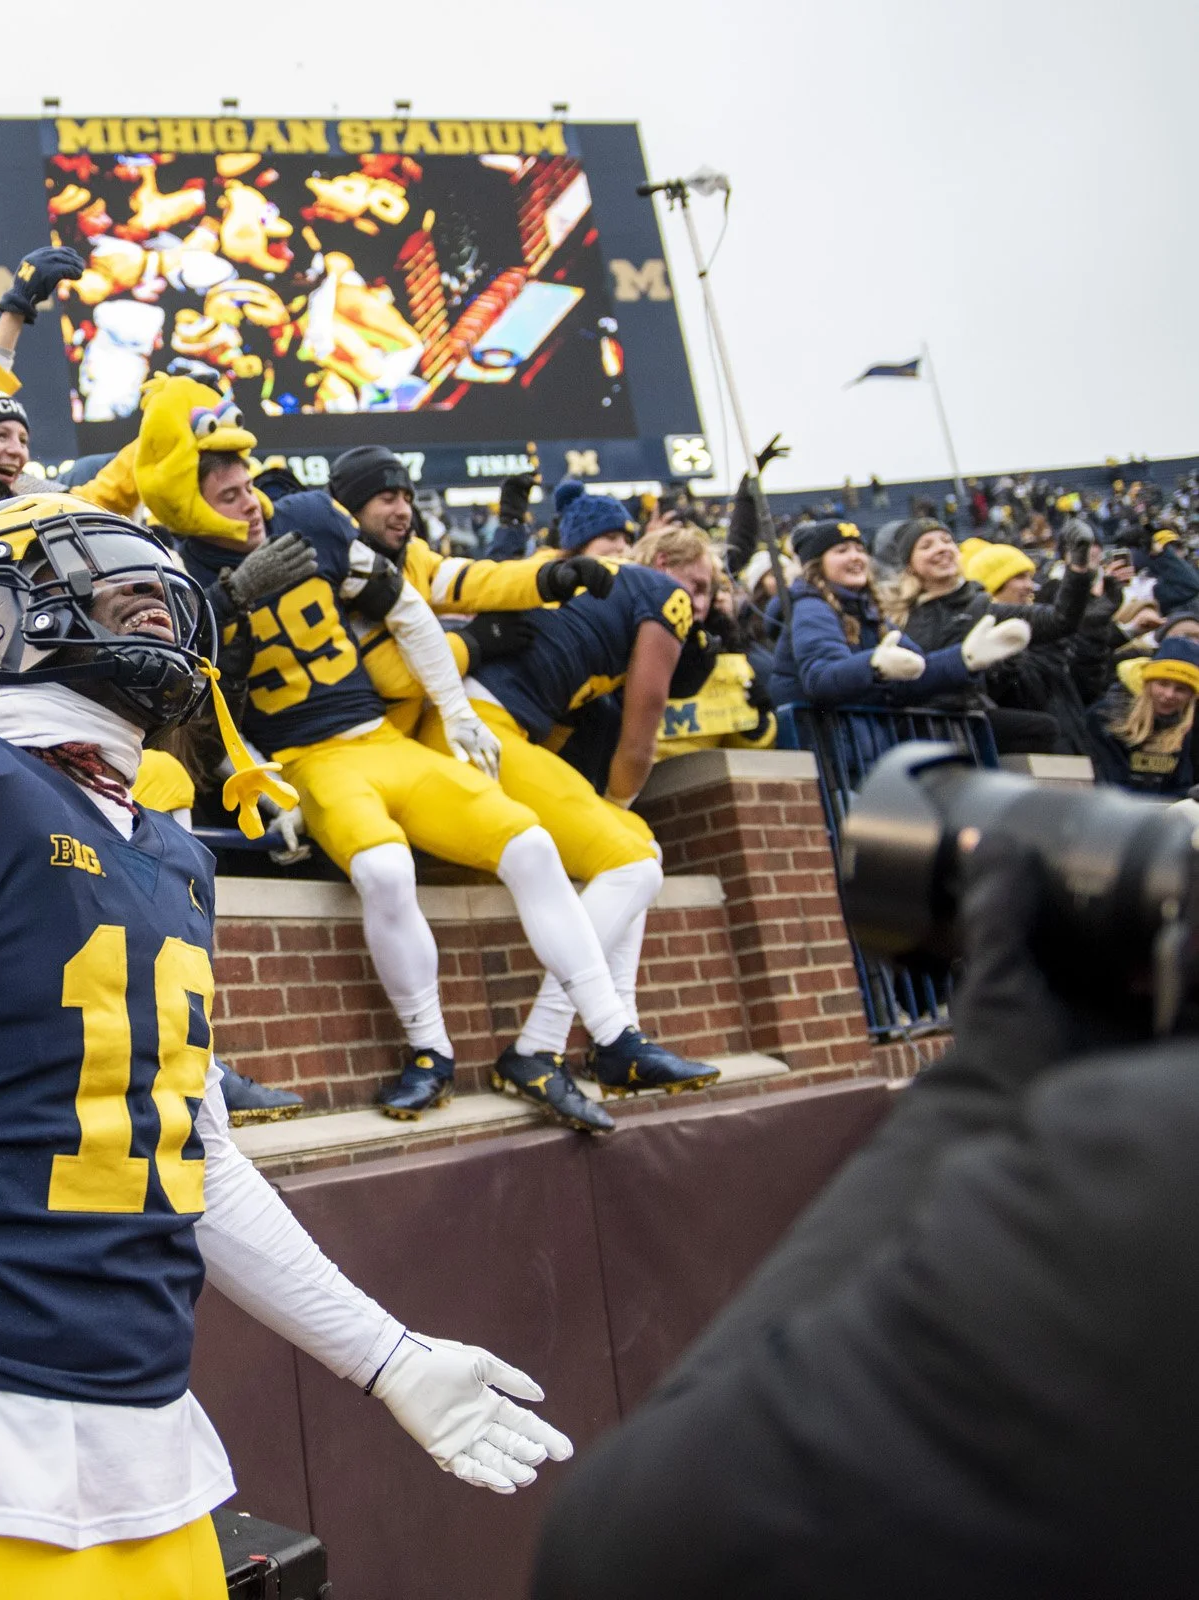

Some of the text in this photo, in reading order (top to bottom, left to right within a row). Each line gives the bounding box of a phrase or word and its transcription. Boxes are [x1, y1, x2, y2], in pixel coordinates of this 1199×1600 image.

[56, 119, 568, 155] MICHIGAN STADIUM
[609, 259, 670, 302] M
[466, 454, 537, 477] FINAL
[664, 702, 700, 735] M
[48, 925, 215, 1214] 18
